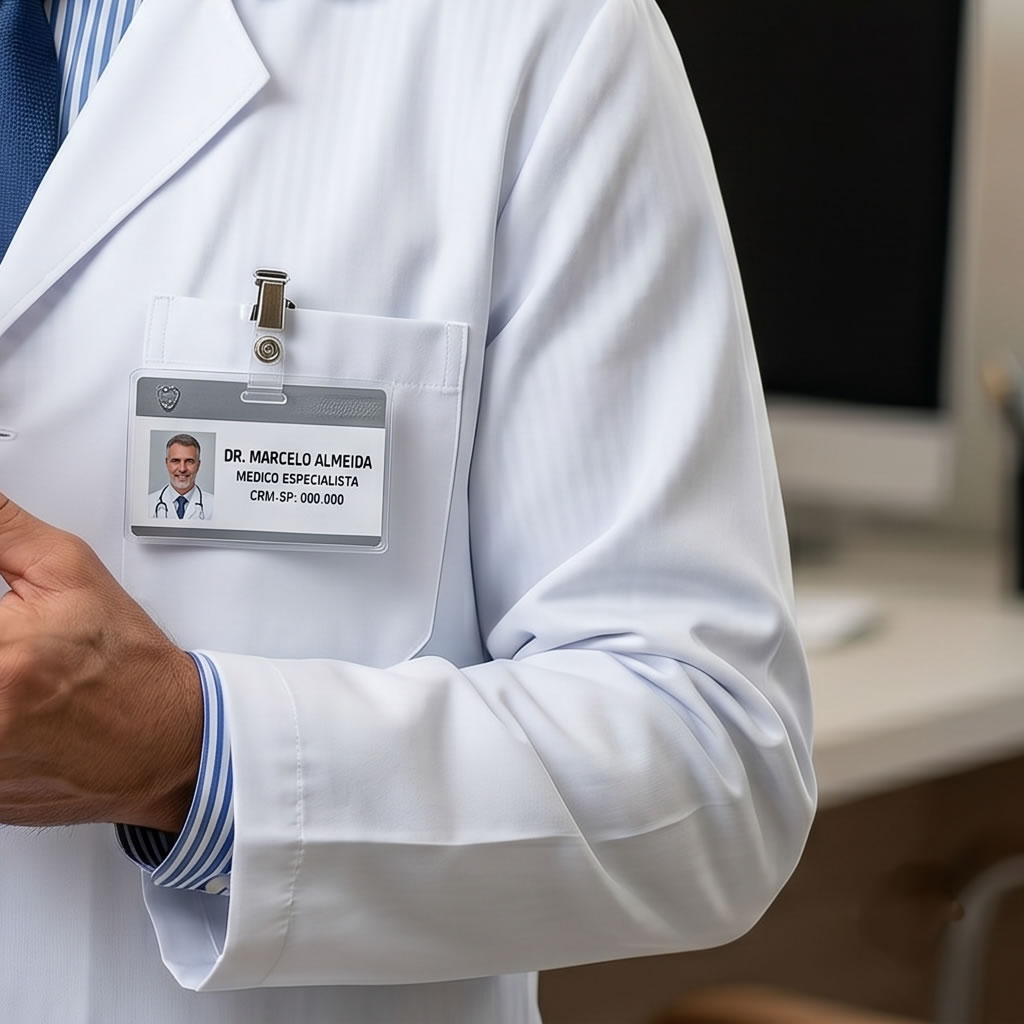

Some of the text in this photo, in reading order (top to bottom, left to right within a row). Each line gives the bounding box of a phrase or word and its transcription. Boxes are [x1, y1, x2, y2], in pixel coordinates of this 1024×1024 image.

[224, 448, 372, 470] DR. MARCELO ALMEIDA
[236, 470, 359, 488] MEDICO ESPECIALISTA
[300, 492, 345, 506] 000.000
